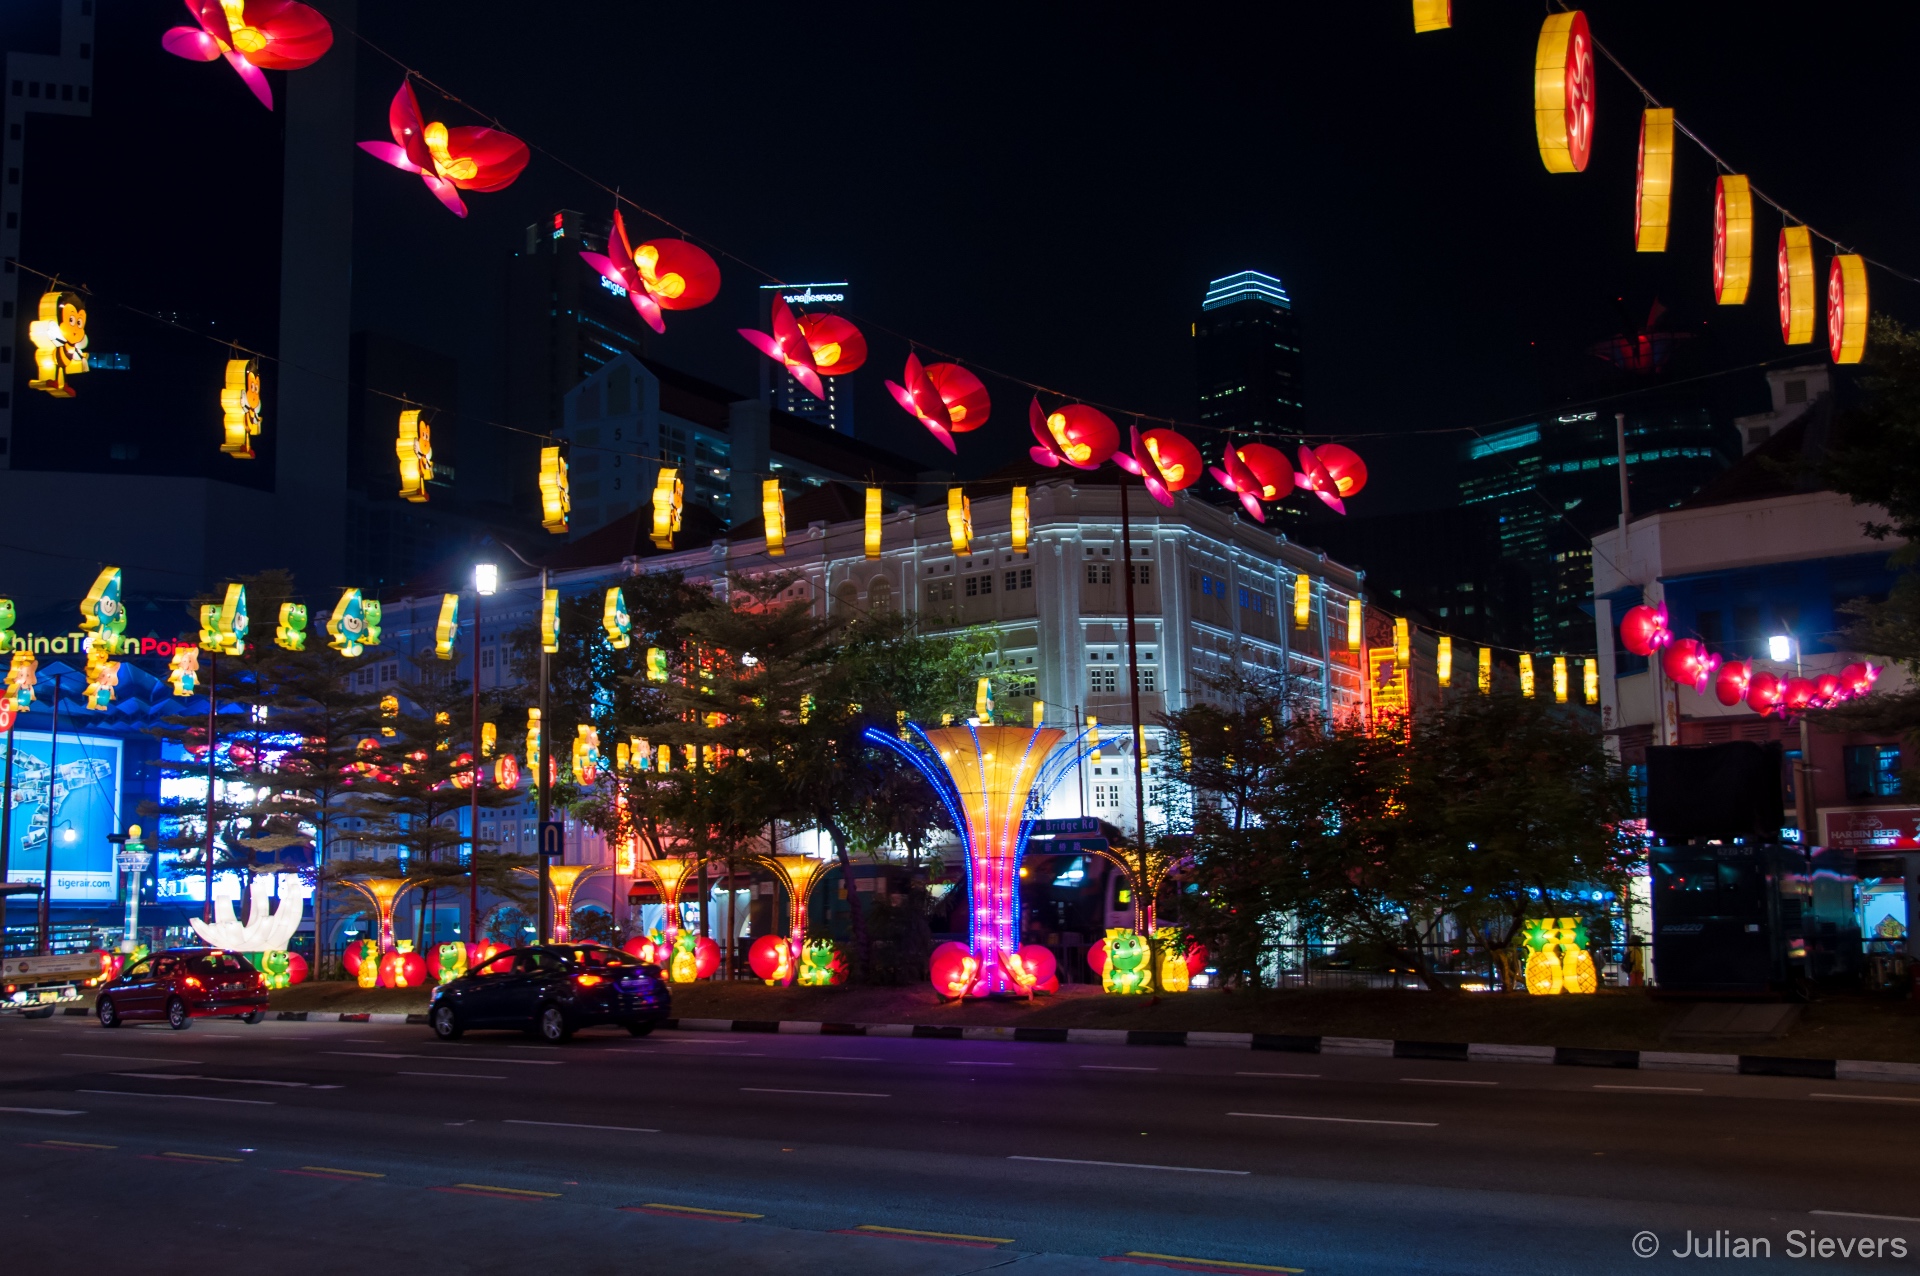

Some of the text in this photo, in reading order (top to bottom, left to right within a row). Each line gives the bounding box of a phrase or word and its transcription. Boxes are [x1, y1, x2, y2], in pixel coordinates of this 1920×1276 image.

[1572, 34, 1590, 103] SG
[1570, 84, 1589, 151] 50
[601, 275, 627, 298] Singtel
[504, 772, 516, 785] 50
[1045, 820, 1078, 832] Bridge
[1082, 818, 1094, 830] Rd
[1831, 828, 1901, 839] HARBIN BEER
[57, 878, 111, 890] tigerair.com
